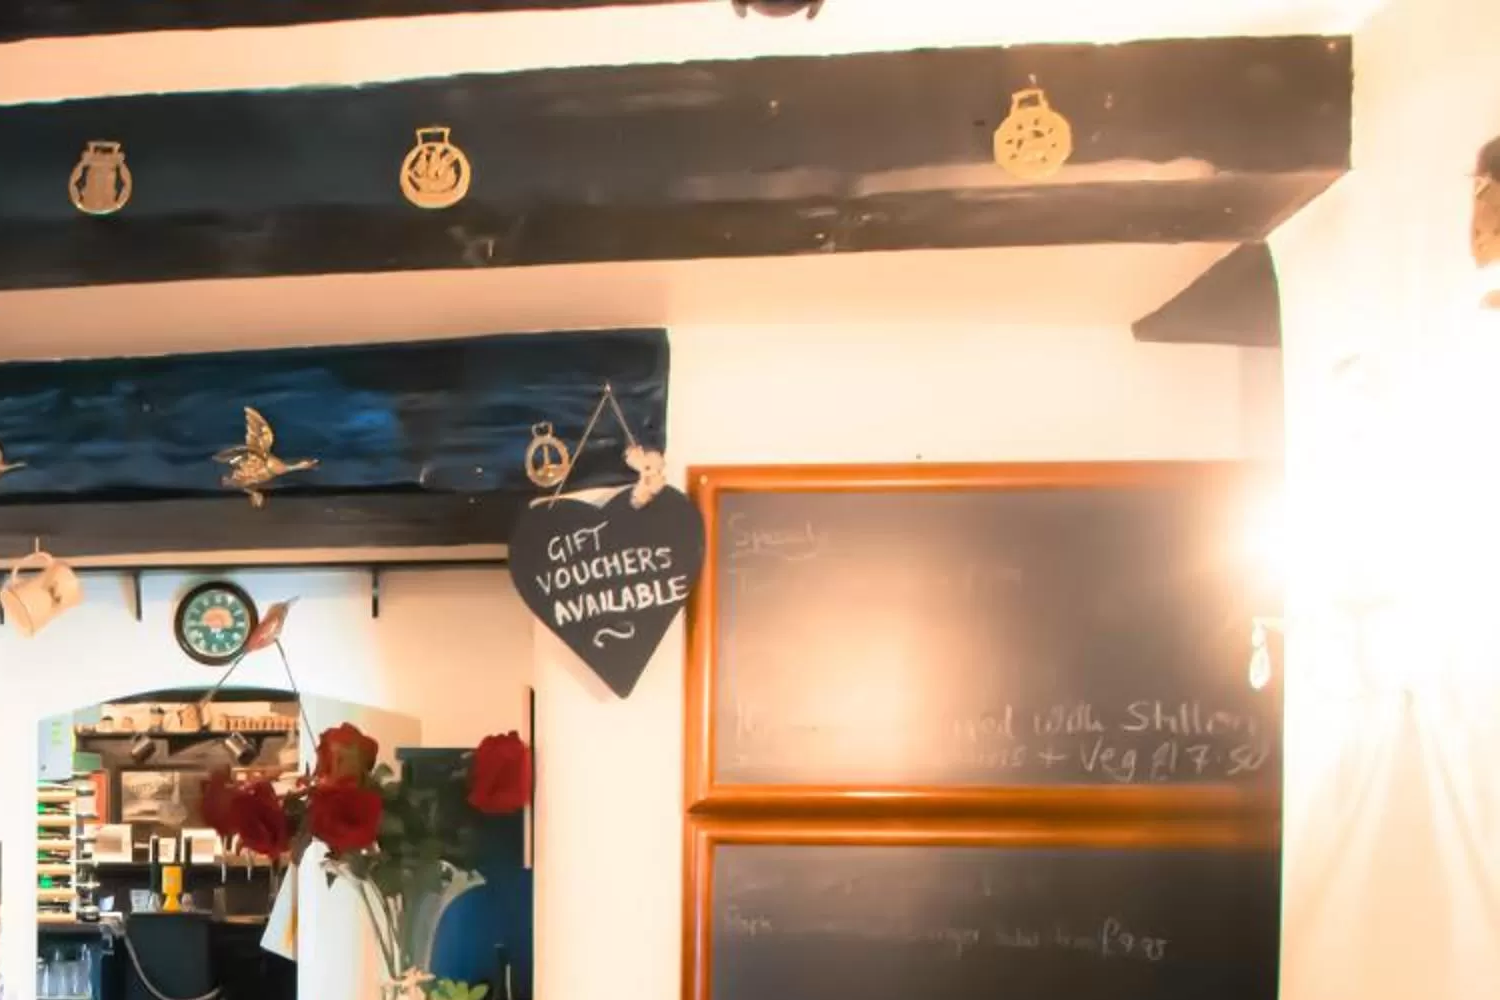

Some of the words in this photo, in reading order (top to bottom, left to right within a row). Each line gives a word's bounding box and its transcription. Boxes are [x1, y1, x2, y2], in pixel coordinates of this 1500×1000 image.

[547, 521, 609, 563] GIFT
[535, 546, 673, 597] VOUCHERS
[553, 574, 691, 627] AVAILABLE
[1079, 735, 1137, 783] Veg
